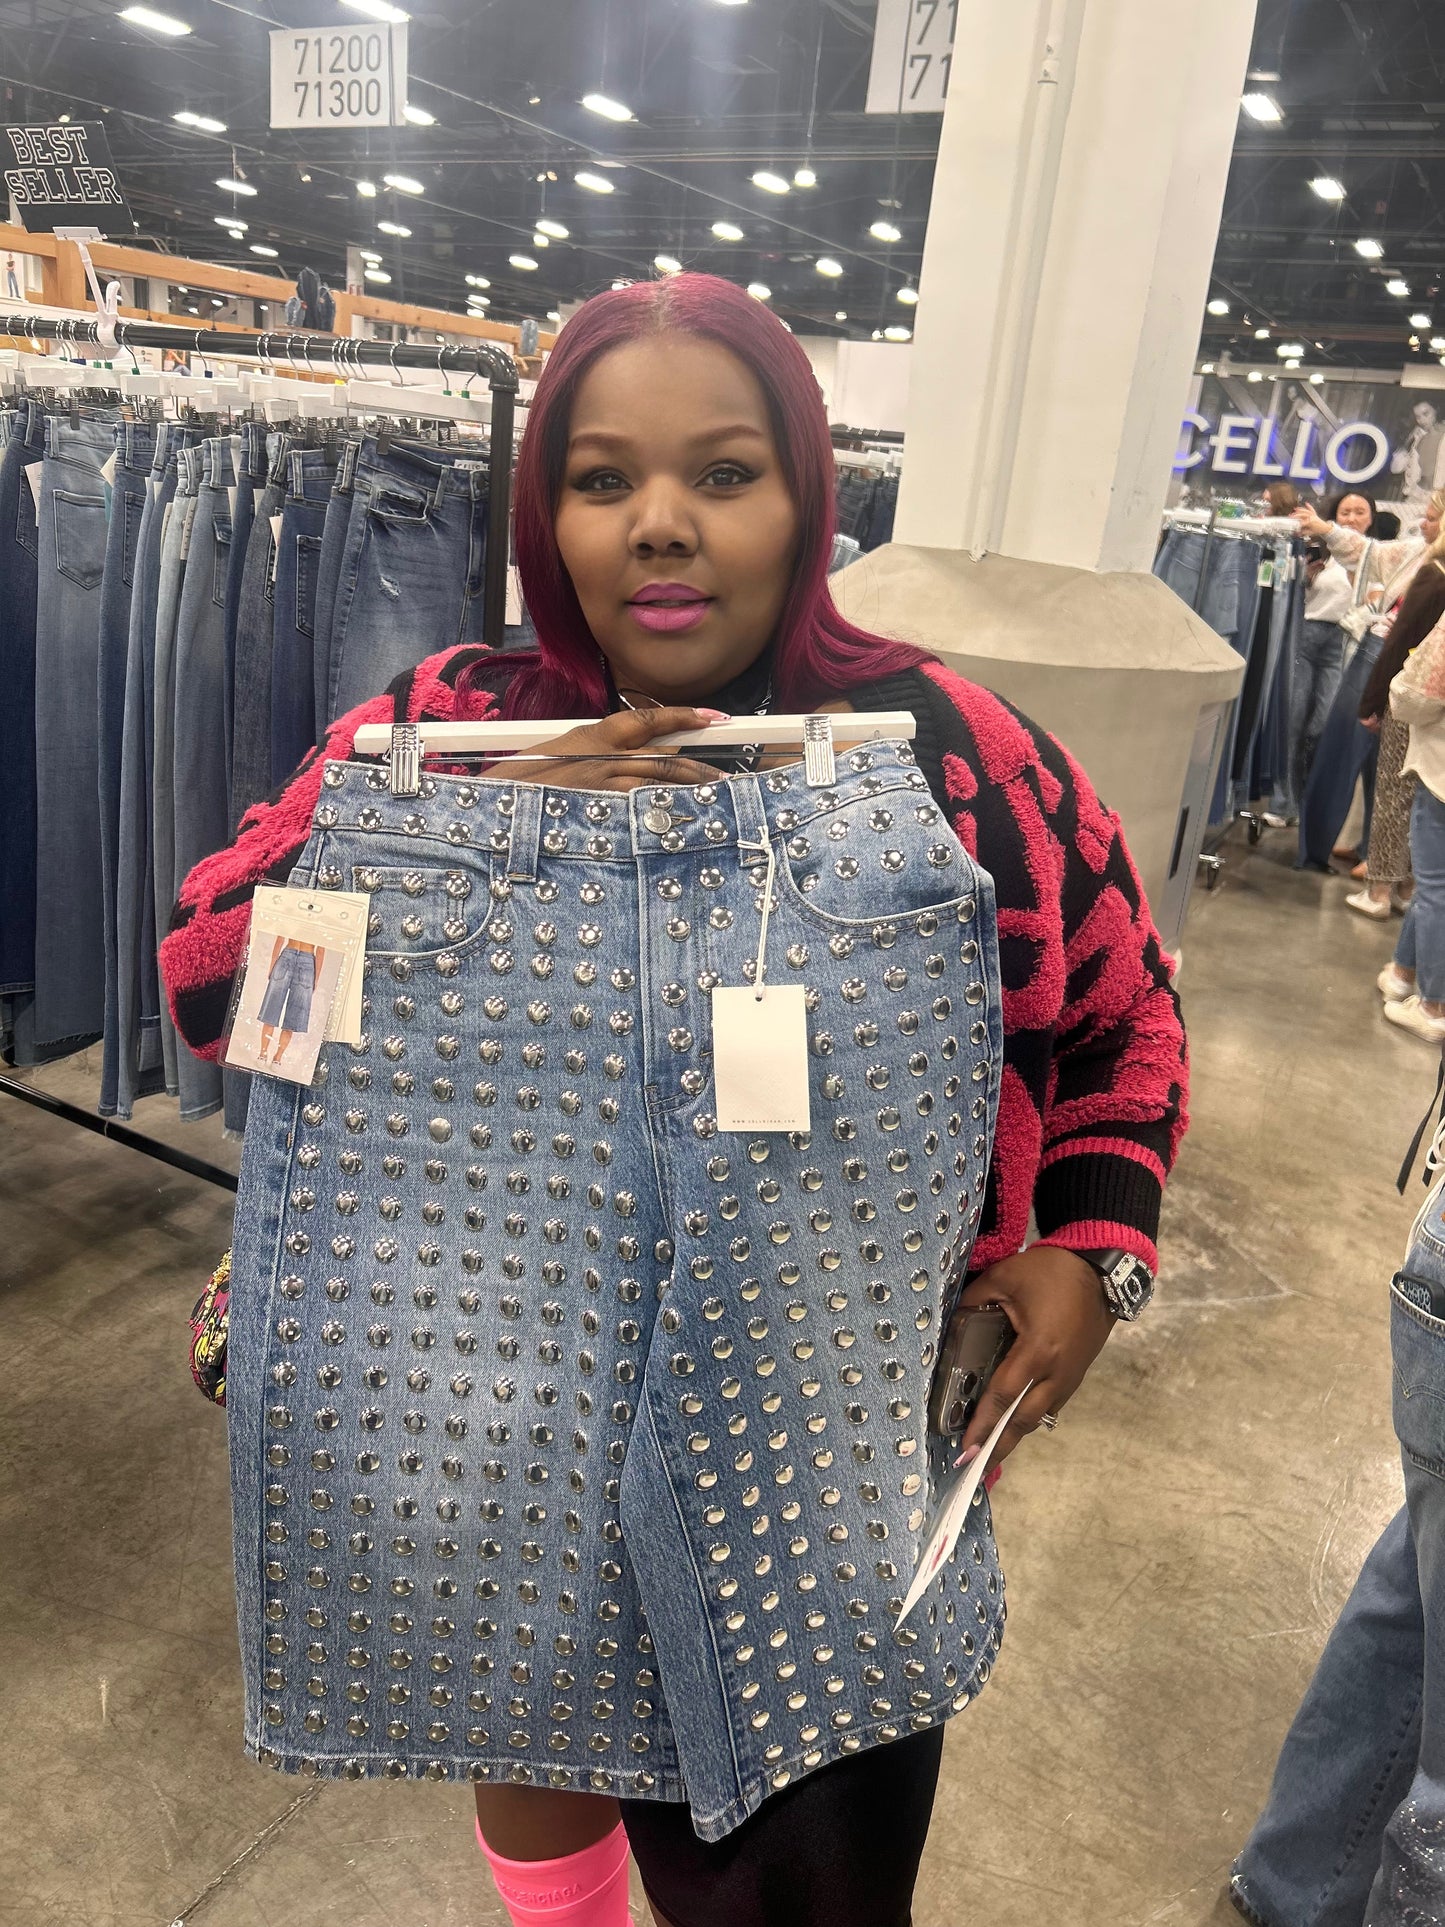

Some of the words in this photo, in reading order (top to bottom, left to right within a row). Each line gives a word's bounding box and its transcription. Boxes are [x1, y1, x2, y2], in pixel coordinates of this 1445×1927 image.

[294, 33, 381, 75] 71200
[294, 78, 381, 118] 71300
[6, 126, 90, 165] BEST
[4, 167, 123, 204] SELLER
[1172, 411, 1389, 484] CELLO
[499, 1880, 583, 1906] LENCIAGA
